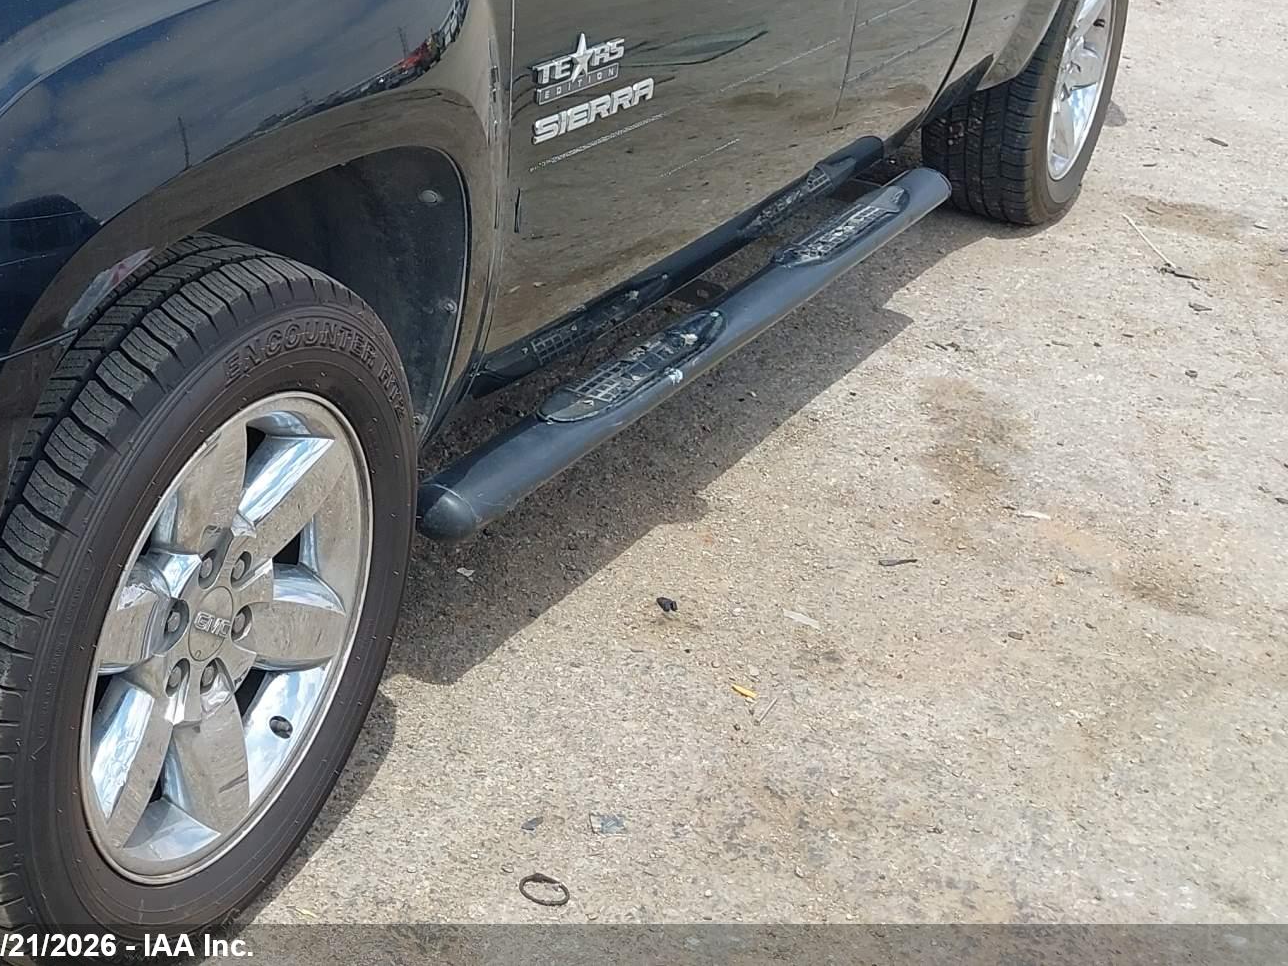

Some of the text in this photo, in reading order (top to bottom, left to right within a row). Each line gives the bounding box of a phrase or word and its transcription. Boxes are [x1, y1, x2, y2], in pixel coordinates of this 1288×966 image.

[532, 33, 625, 84] TEXAS
[543, 65, 616, 100] EDITION
[532, 77, 654, 145] SIERRA
[224, 321, 379, 380] ENCOUNTER
[193, 611, 232, 638] GMC
